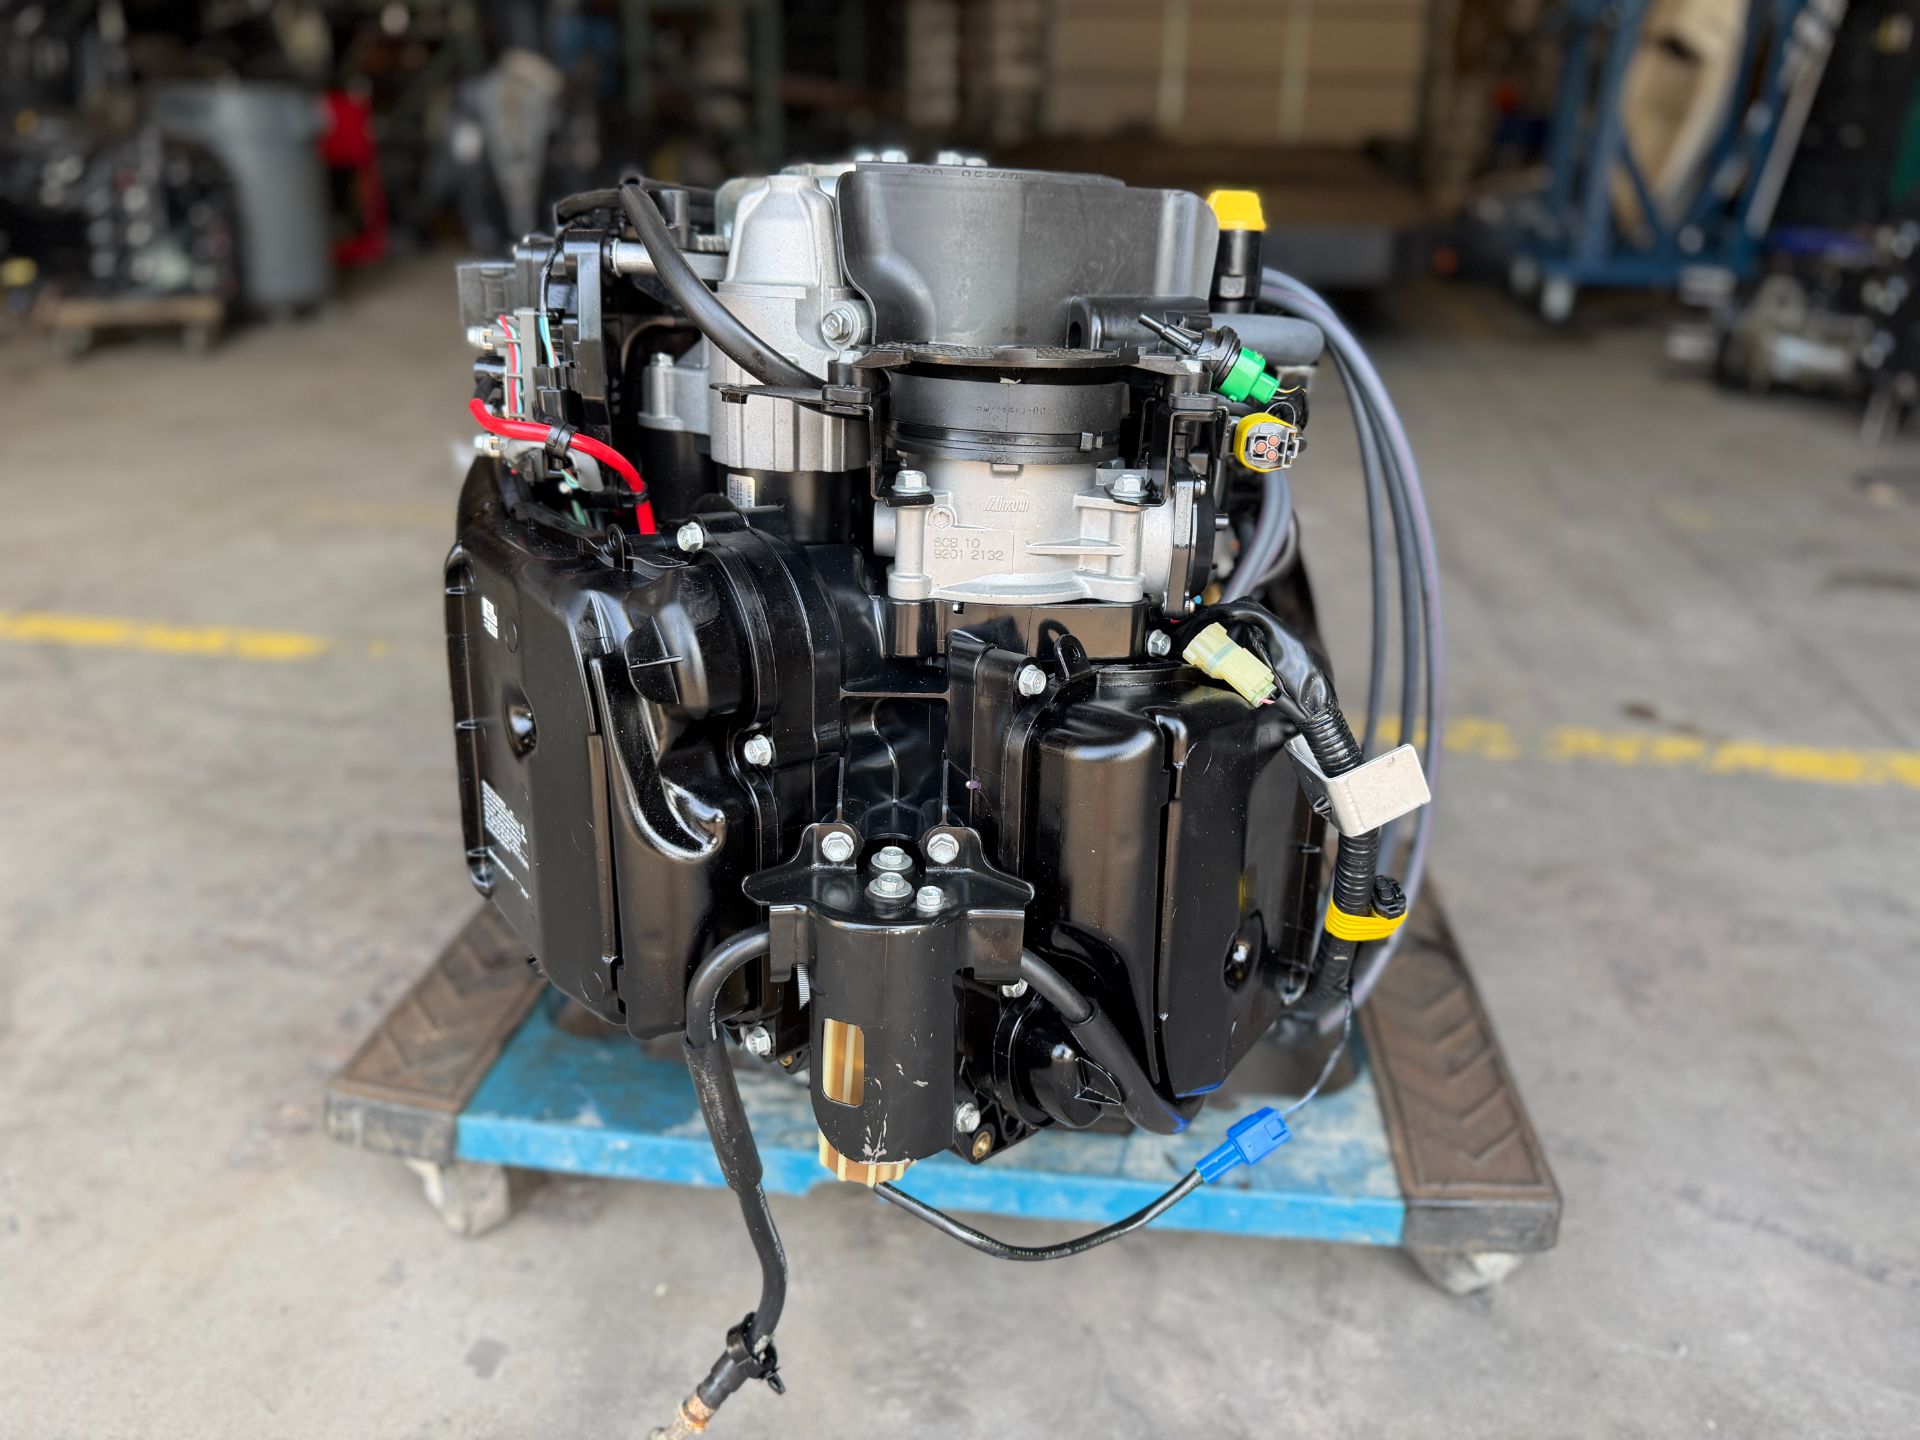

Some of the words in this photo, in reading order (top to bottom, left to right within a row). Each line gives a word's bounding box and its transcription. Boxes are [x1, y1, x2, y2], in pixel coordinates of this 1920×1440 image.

[965, 538, 981, 549] 10
[933, 548, 963, 560] 9201
[970, 549, 1004, 561] 2132
